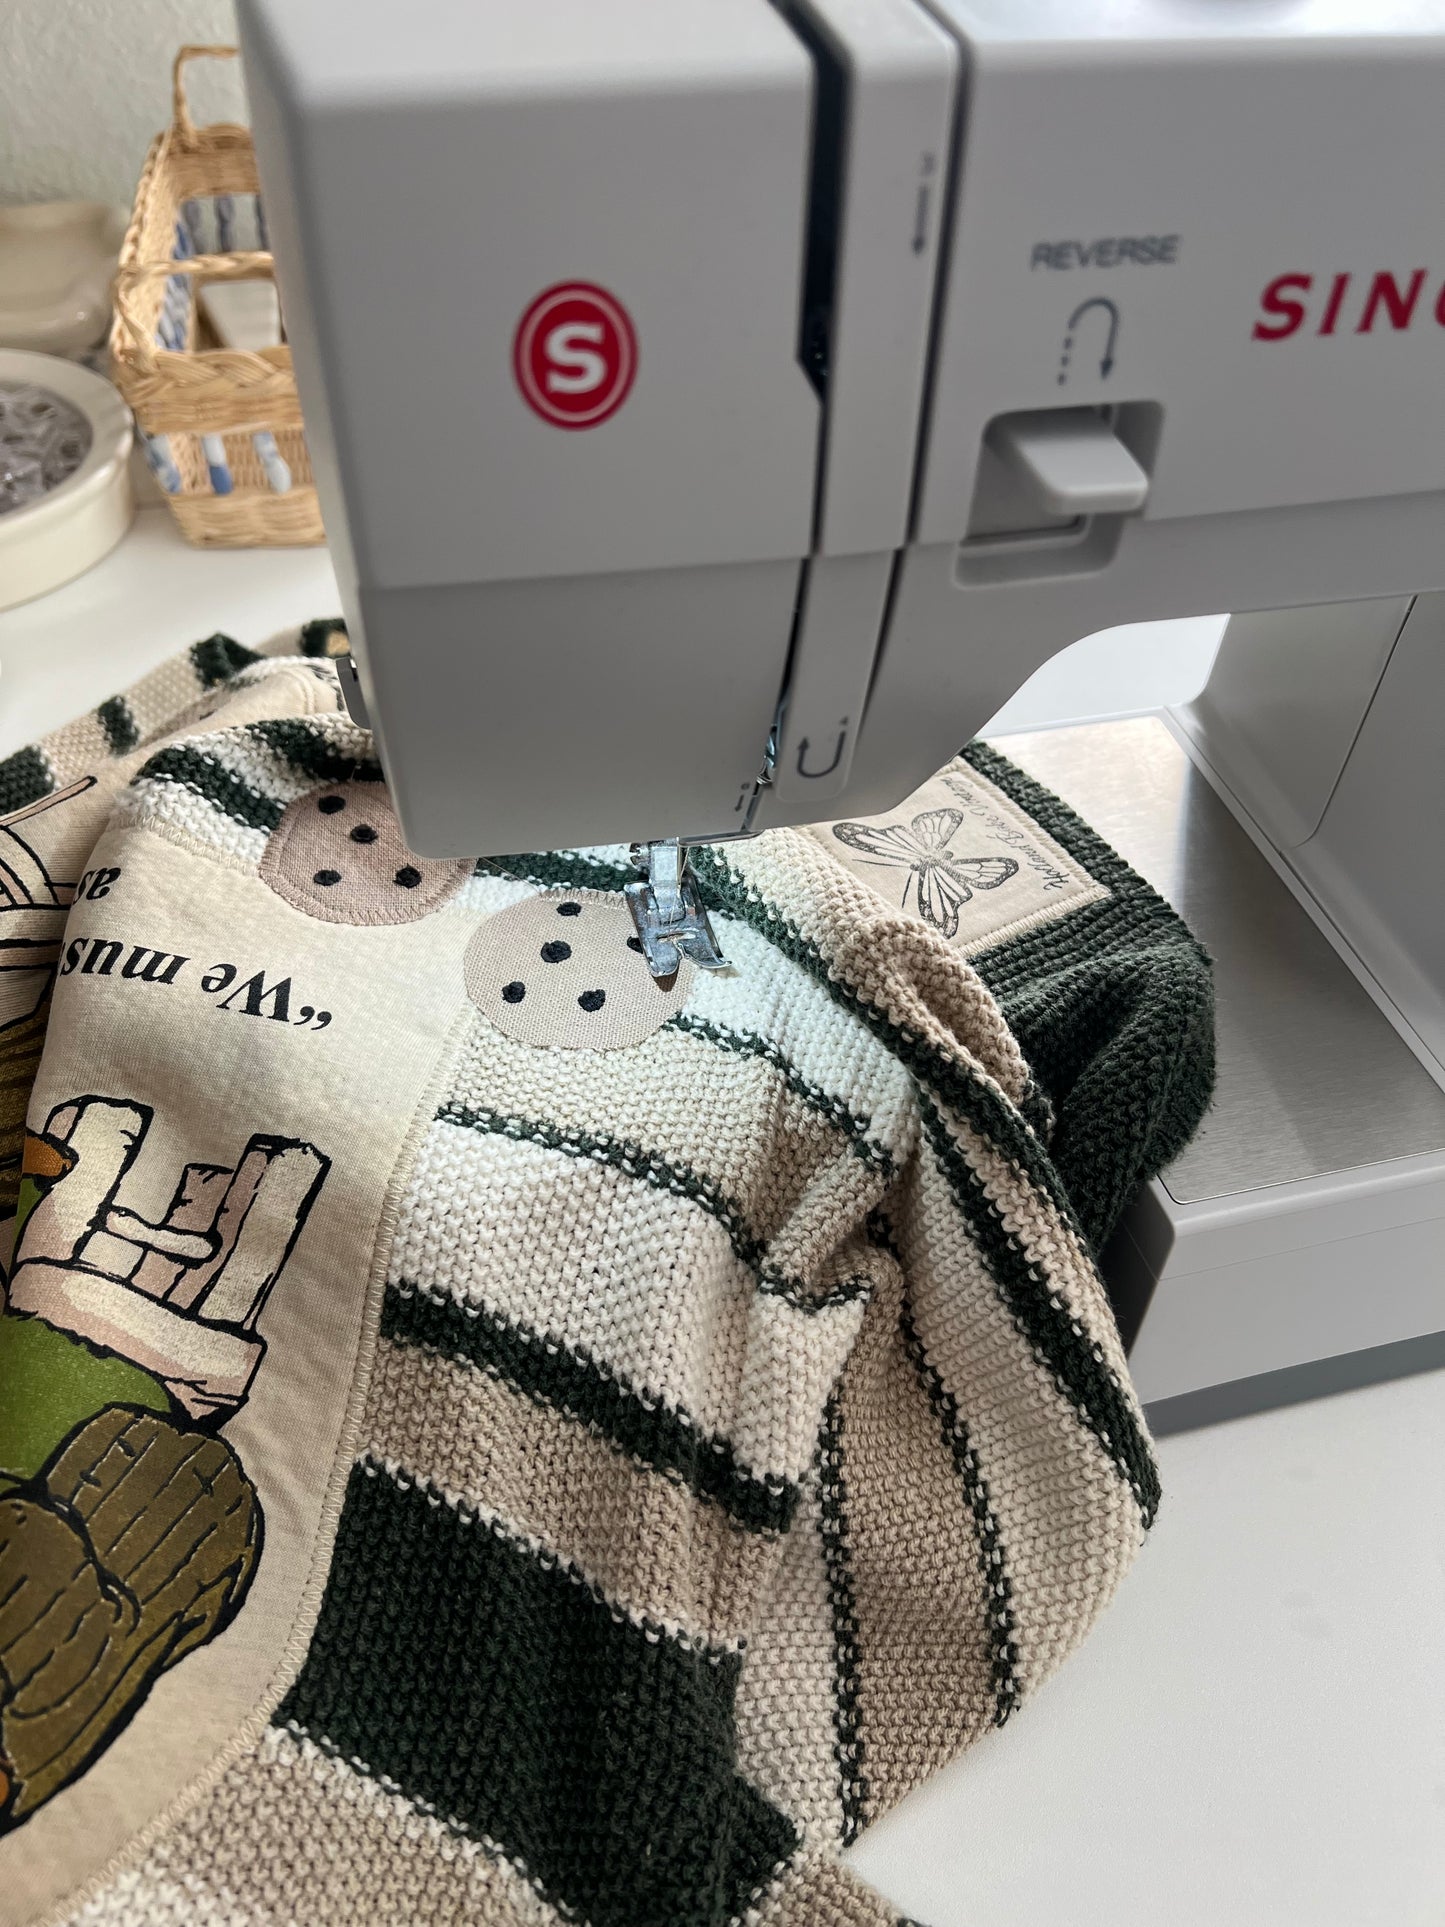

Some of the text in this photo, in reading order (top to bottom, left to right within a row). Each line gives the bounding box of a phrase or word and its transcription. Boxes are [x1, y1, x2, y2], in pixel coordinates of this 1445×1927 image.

[1030, 234, 1181, 272] REVERSE
[1251, 268, 1445, 342] SIN
[544, 321, 608, 394] S
[59, 937, 191, 985] mus
